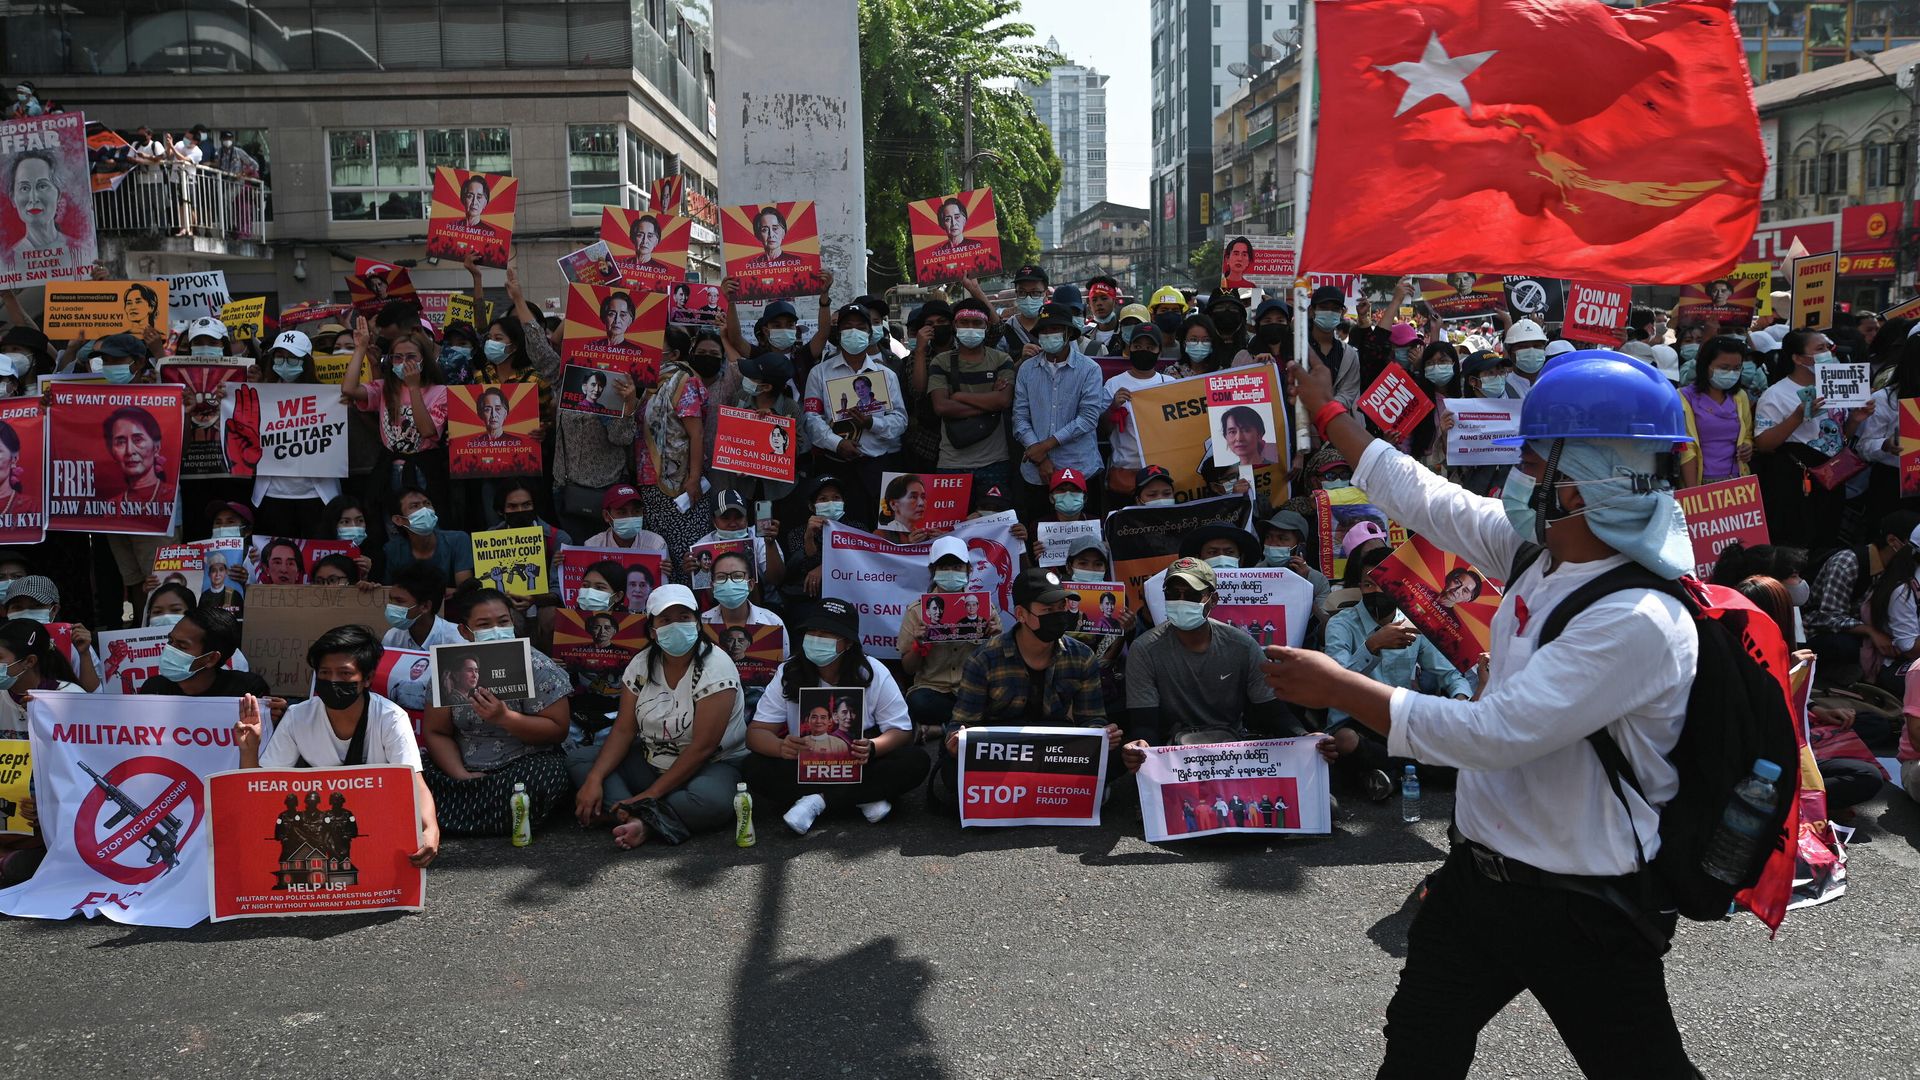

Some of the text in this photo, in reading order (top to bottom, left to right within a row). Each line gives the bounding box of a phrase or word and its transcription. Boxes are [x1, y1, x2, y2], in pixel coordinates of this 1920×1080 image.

[42, 116, 78, 130] FROM
[2, 131, 60, 154] FEAR
[446, 224, 495, 237] PLEASE SAVE OUR
[932, 248, 951, 257] PLEASE
[952, 245, 968, 253] SAVE
[27, 259, 60, 270] LEADER
[636, 264, 652, 272] SAVE
[745, 261, 767, 269] PLEASE
[768, 260, 786, 268] SAVE
[1254, 264, 1267, 272] not
[1800, 262, 1832, 276] JUSTICE
[1853, 258, 1873, 269] FIVE
[27, 265, 94, 281] SAN SUU KYI
[1741, 271, 1768, 280] Accept
[156, 274, 218, 290] UPPORT
[1806, 281, 1824, 289] MUST
[1607, 292, 1620, 307] IN
[1803, 296, 1825, 306] WIN
[583, 344, 606, 352] PLEASE
[607, 347, 625, 355] SAVE
[328, 363, 344, 371] Don't
[1384, 373, 1399, 390] IN
[56, 394, 176, 407] WE WANT OUR LEADER
[1212, 391, 1232, 402] CDM
[277, 396, 316, 418] WE
[722, 409, 749, 419] RELEASE
[265, 413, 327, 432] AGAINST
[261, 422, 346, 447] MILITARY
[733, 437, 755, 446] LEADER
[274, 438, 332, 460] COUP
[719, 446, 791, 465] AUNG SAN SUU KYI
[717, 456, 788, 475] AND ARRESTED PERSONS
[53, 460, 96, 497] FREE
[1062, 469, 1074, 479] A
[933, 478, 963, 488] FREE
[51, 500, 144, 515] DAW AUNG SAN
[934, 501, 955, 509] OUR
[17, 512, 41, 527] KYI
[925, 520, 961, 529] LEADER
[1060, 525, 1079, 535] Fight
[1081, 524, 1093, 532] For
[474, 534, 542, 549] We Don't Accept
[832, 534, 876, 550] Release
[477, 545, 541, 561] MILITARY COUP
[1043, 551, 1066, 559] Reject
[154, 560, 181, 570] CDM
[831, 568, 898, 582] Our Leader
[252, 588, 344, 607] PLEASE SAVE
[874, 604, 901, 615] SAN
[1415, 583, 1459, 629] PLEASE SAVE OUR
[491, 669, 506, 679] FREE
[499, 685, 508, 694] SAN
[518, 683, 527, 692] KYI
[53, 723, 166, 747] MILITARY
[975, 742, 1035, 762] FREE
[1158, 746, 1177, 754] CIVIL
[1044, 756, 1090, 764] MEMBERS
[806, 765, 853, 778] FREE
[248, 777, 373, 792] HEAR OUR VOICE
[1037, 786, 1091, 796] ELECTORAL
[967, 785, 1027, 804] STOP
[1036, 797, 1069, 805] FRAUD
[96, 780, 189, 859] STOP DICTACTORSHIP
[287, 881, 347, 893] HELP US!
[236, 894, 268, 902] MILITARY
[286, 893, 315, 901] POLICES
[332, 891, 372, 900] ARRESTING
[374, 888, 402, 897] PEOPLE
[309, 900, 343, 908] WARRANT
[362, 897, 399, 905] REASONS.
